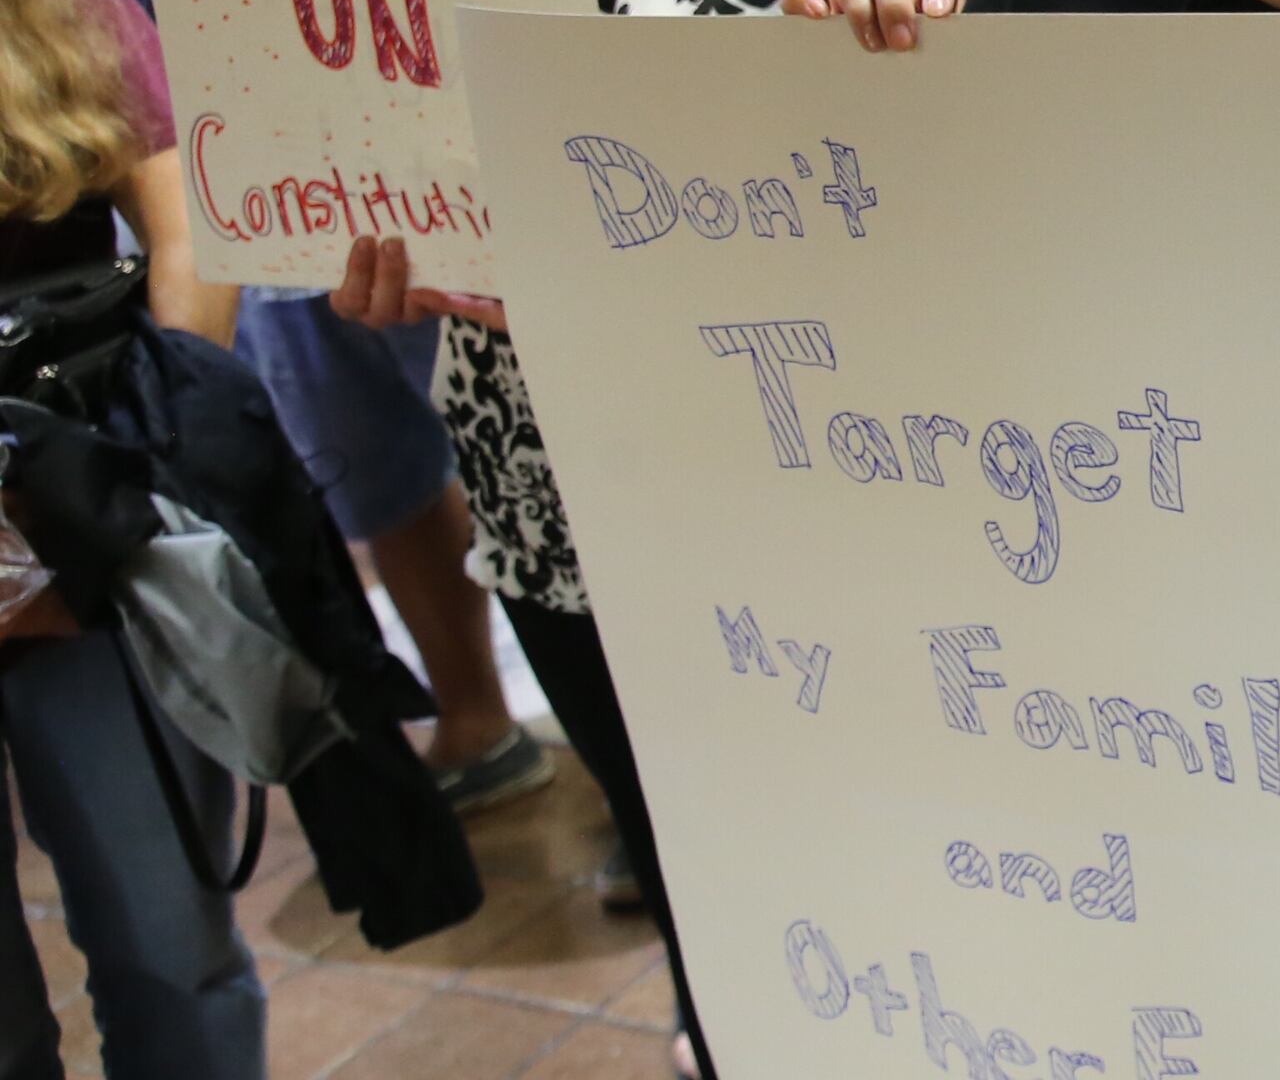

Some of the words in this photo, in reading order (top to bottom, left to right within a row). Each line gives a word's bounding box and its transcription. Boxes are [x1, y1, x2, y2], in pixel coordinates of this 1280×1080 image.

[189, 113, 491, 243] Constituti
[564, 135, 877, 250] Don't
[699, 320, 1201, 585] Target
[715, 604, 832, 713] My
[944, 832, 1137, 923] and
